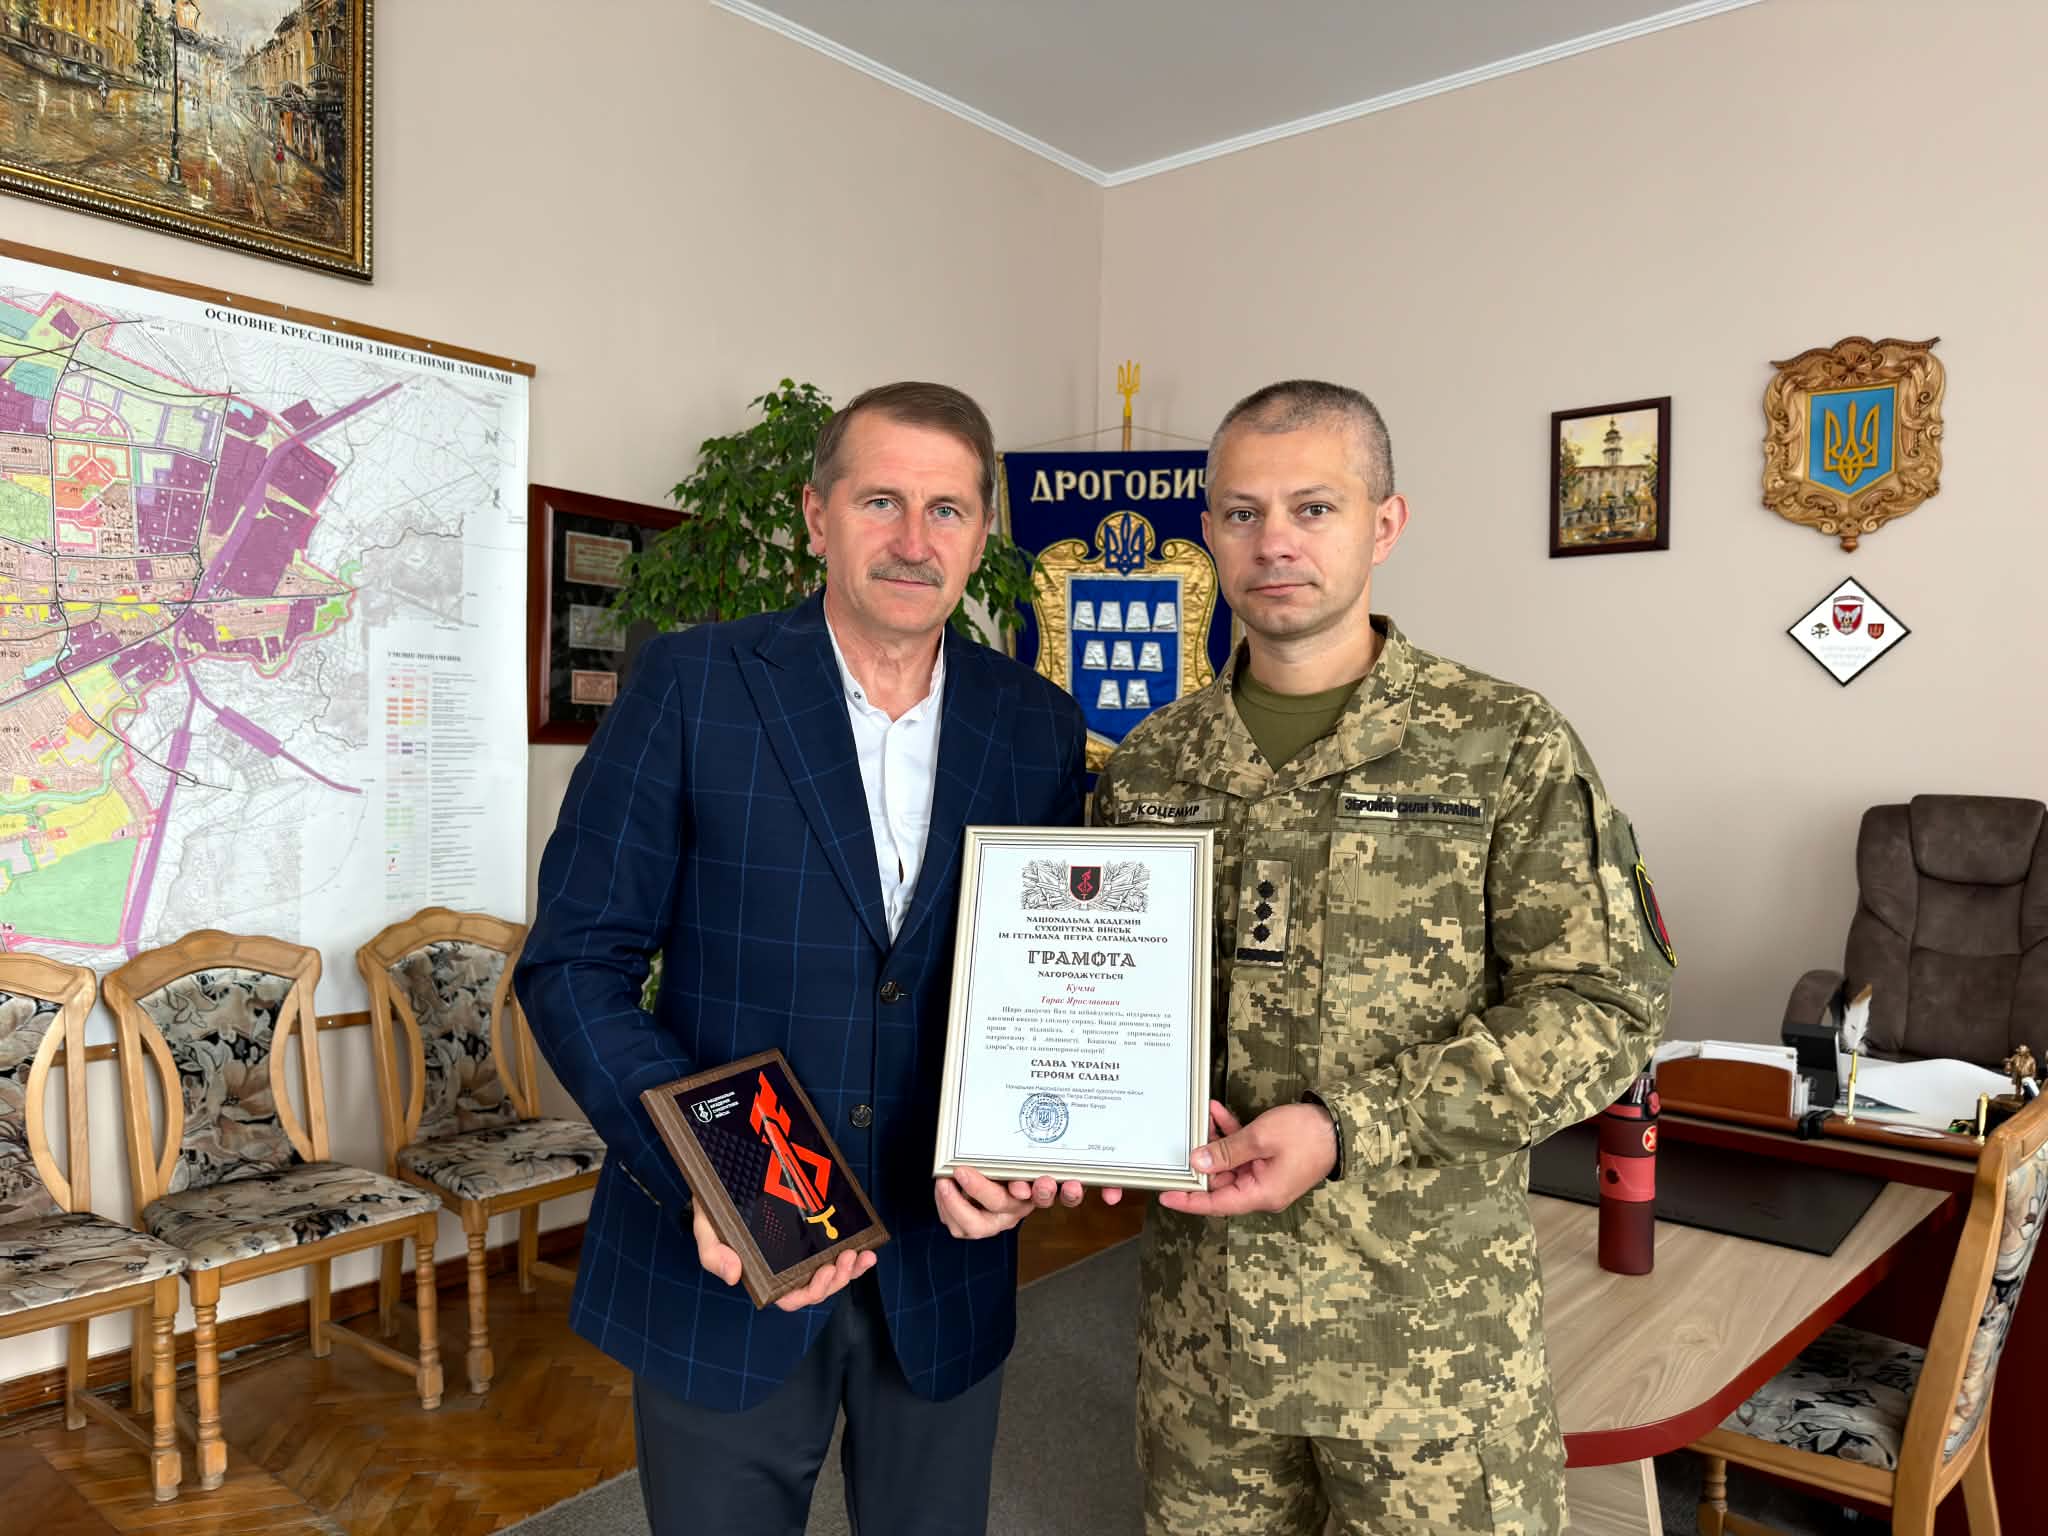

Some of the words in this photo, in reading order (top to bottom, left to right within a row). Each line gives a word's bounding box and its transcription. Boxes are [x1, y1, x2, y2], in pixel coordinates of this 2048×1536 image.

[205, 307, 278, 333] ОСНОВНЕ
[281, 324, 363, 352] КРЕСЛЕННЯ
[376, 344, 455, 373] ВНЕСЕНИМИ
[458, 364, 513, 385] ЗМІНАМИ
[1094, 917, 1141, 926] АКАДЕМІЯ
[1097, 926, 1132, 934] ВІЙСЬК
[1063, 933, 1093, 942] ПЕТРА
[1028, 950, 1136, 968] ГРАМОТА
[1038, 970, 1124, 980] НАГОРОДЖУЄТЬСЯ
[1066, 983, 1096, 994] Кучма
[1041, 995, 1065, 1005] Тарас
[1067, 996, 1121, 1007] Ярославович
[1031, 1059, 1068, 1068] СЛАВА
[1030, 1070, 1075, 1080] ГЕРОЯМ
[1078, 1072, 1120, 1081] СЛАВА!
